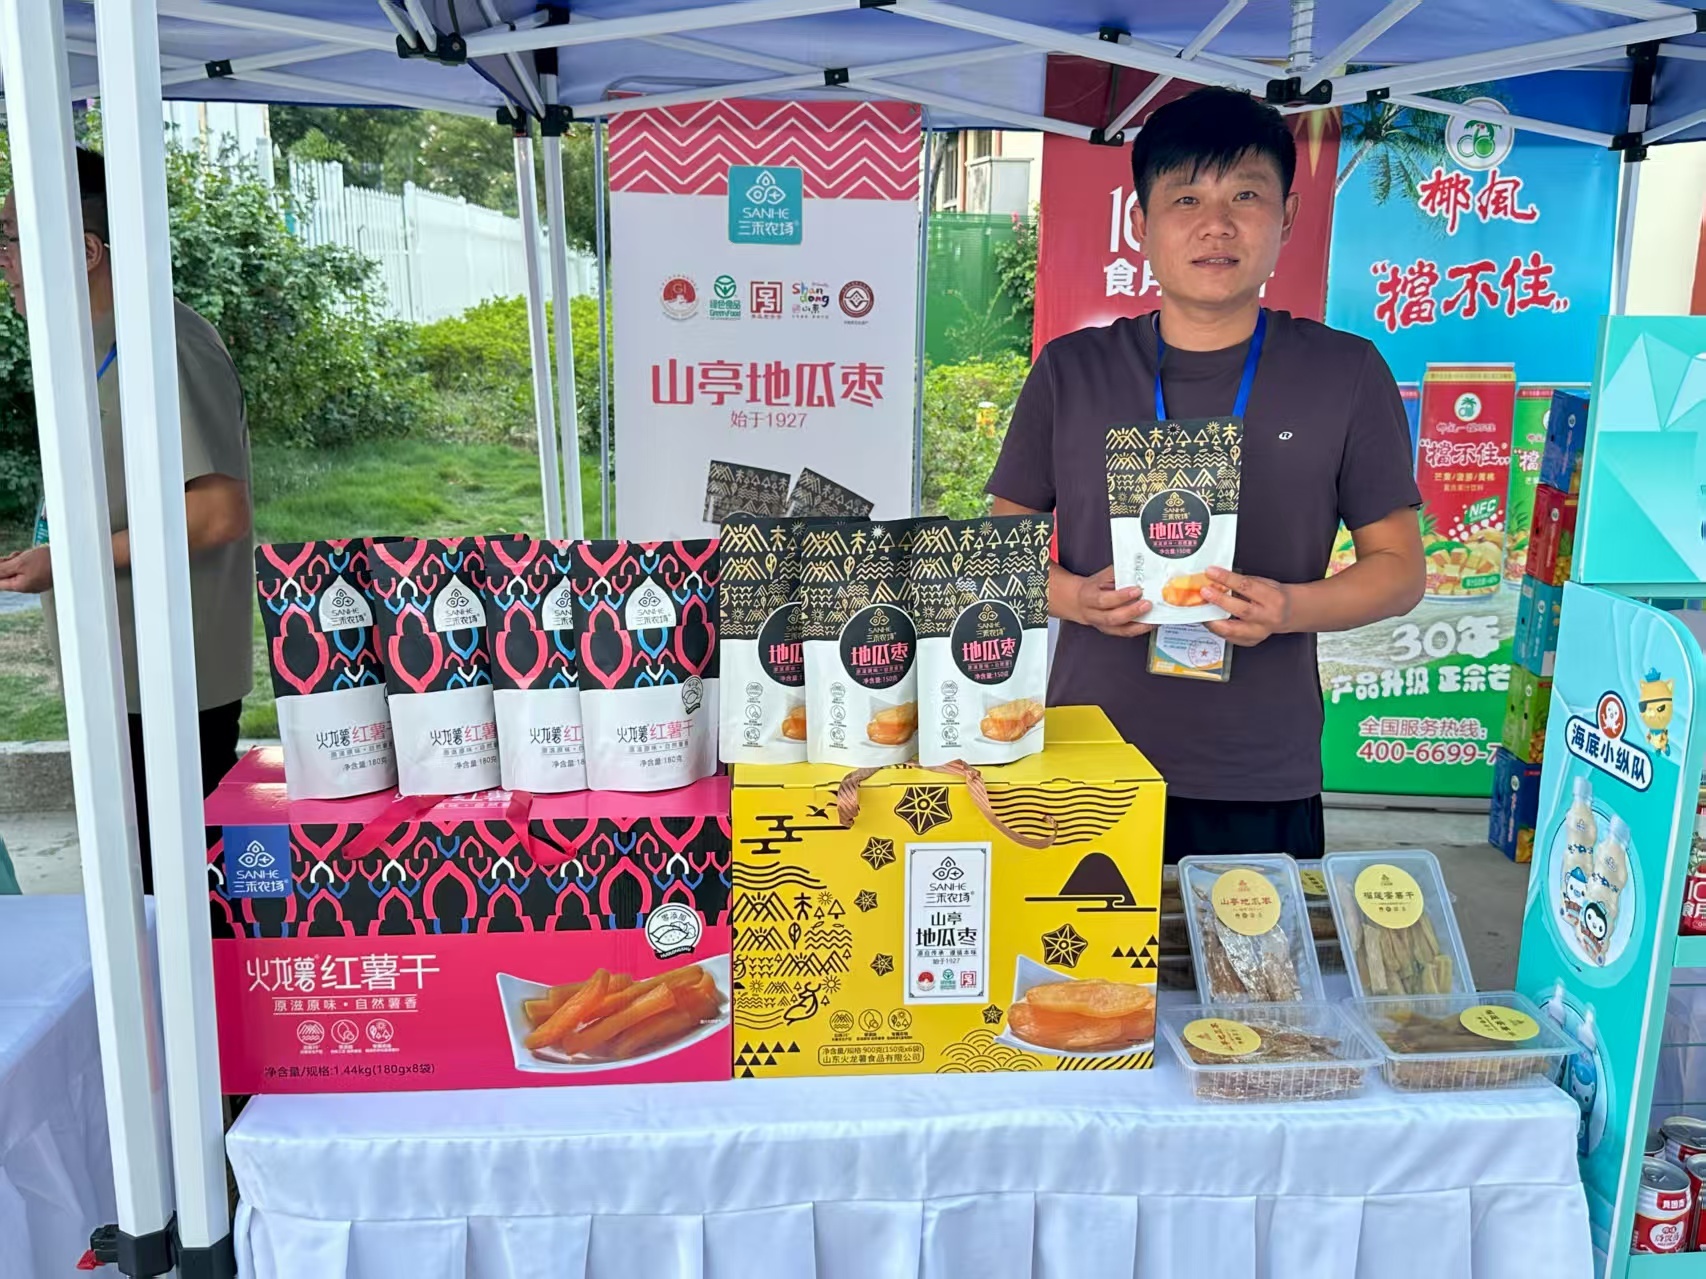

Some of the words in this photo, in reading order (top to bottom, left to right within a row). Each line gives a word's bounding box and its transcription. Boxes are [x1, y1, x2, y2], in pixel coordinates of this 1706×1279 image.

[742, 207, 790, 220] SANHE
[651, 358, 885, 408] 山亭地瓜枣
[731, 411, 808, 428] 始于1927
[1469, 499, 1497, 517] NFC
[1149, 521, 1203, 540] 地瓜枣
[331, 607, 360, 617] SANHE
[851, 642, 909, 666] 地瓜枣
[962, 637, 1017, 662] 地瓜枣
[1570, 722, 1647, 785] 海底小纵队
[236, 869, 280, 880] SANHE
[929, 882, 968, 892] SANHE
[931, 911, 962, 926] 山亭
[916, 926, 978, 947] 地瓜枣
